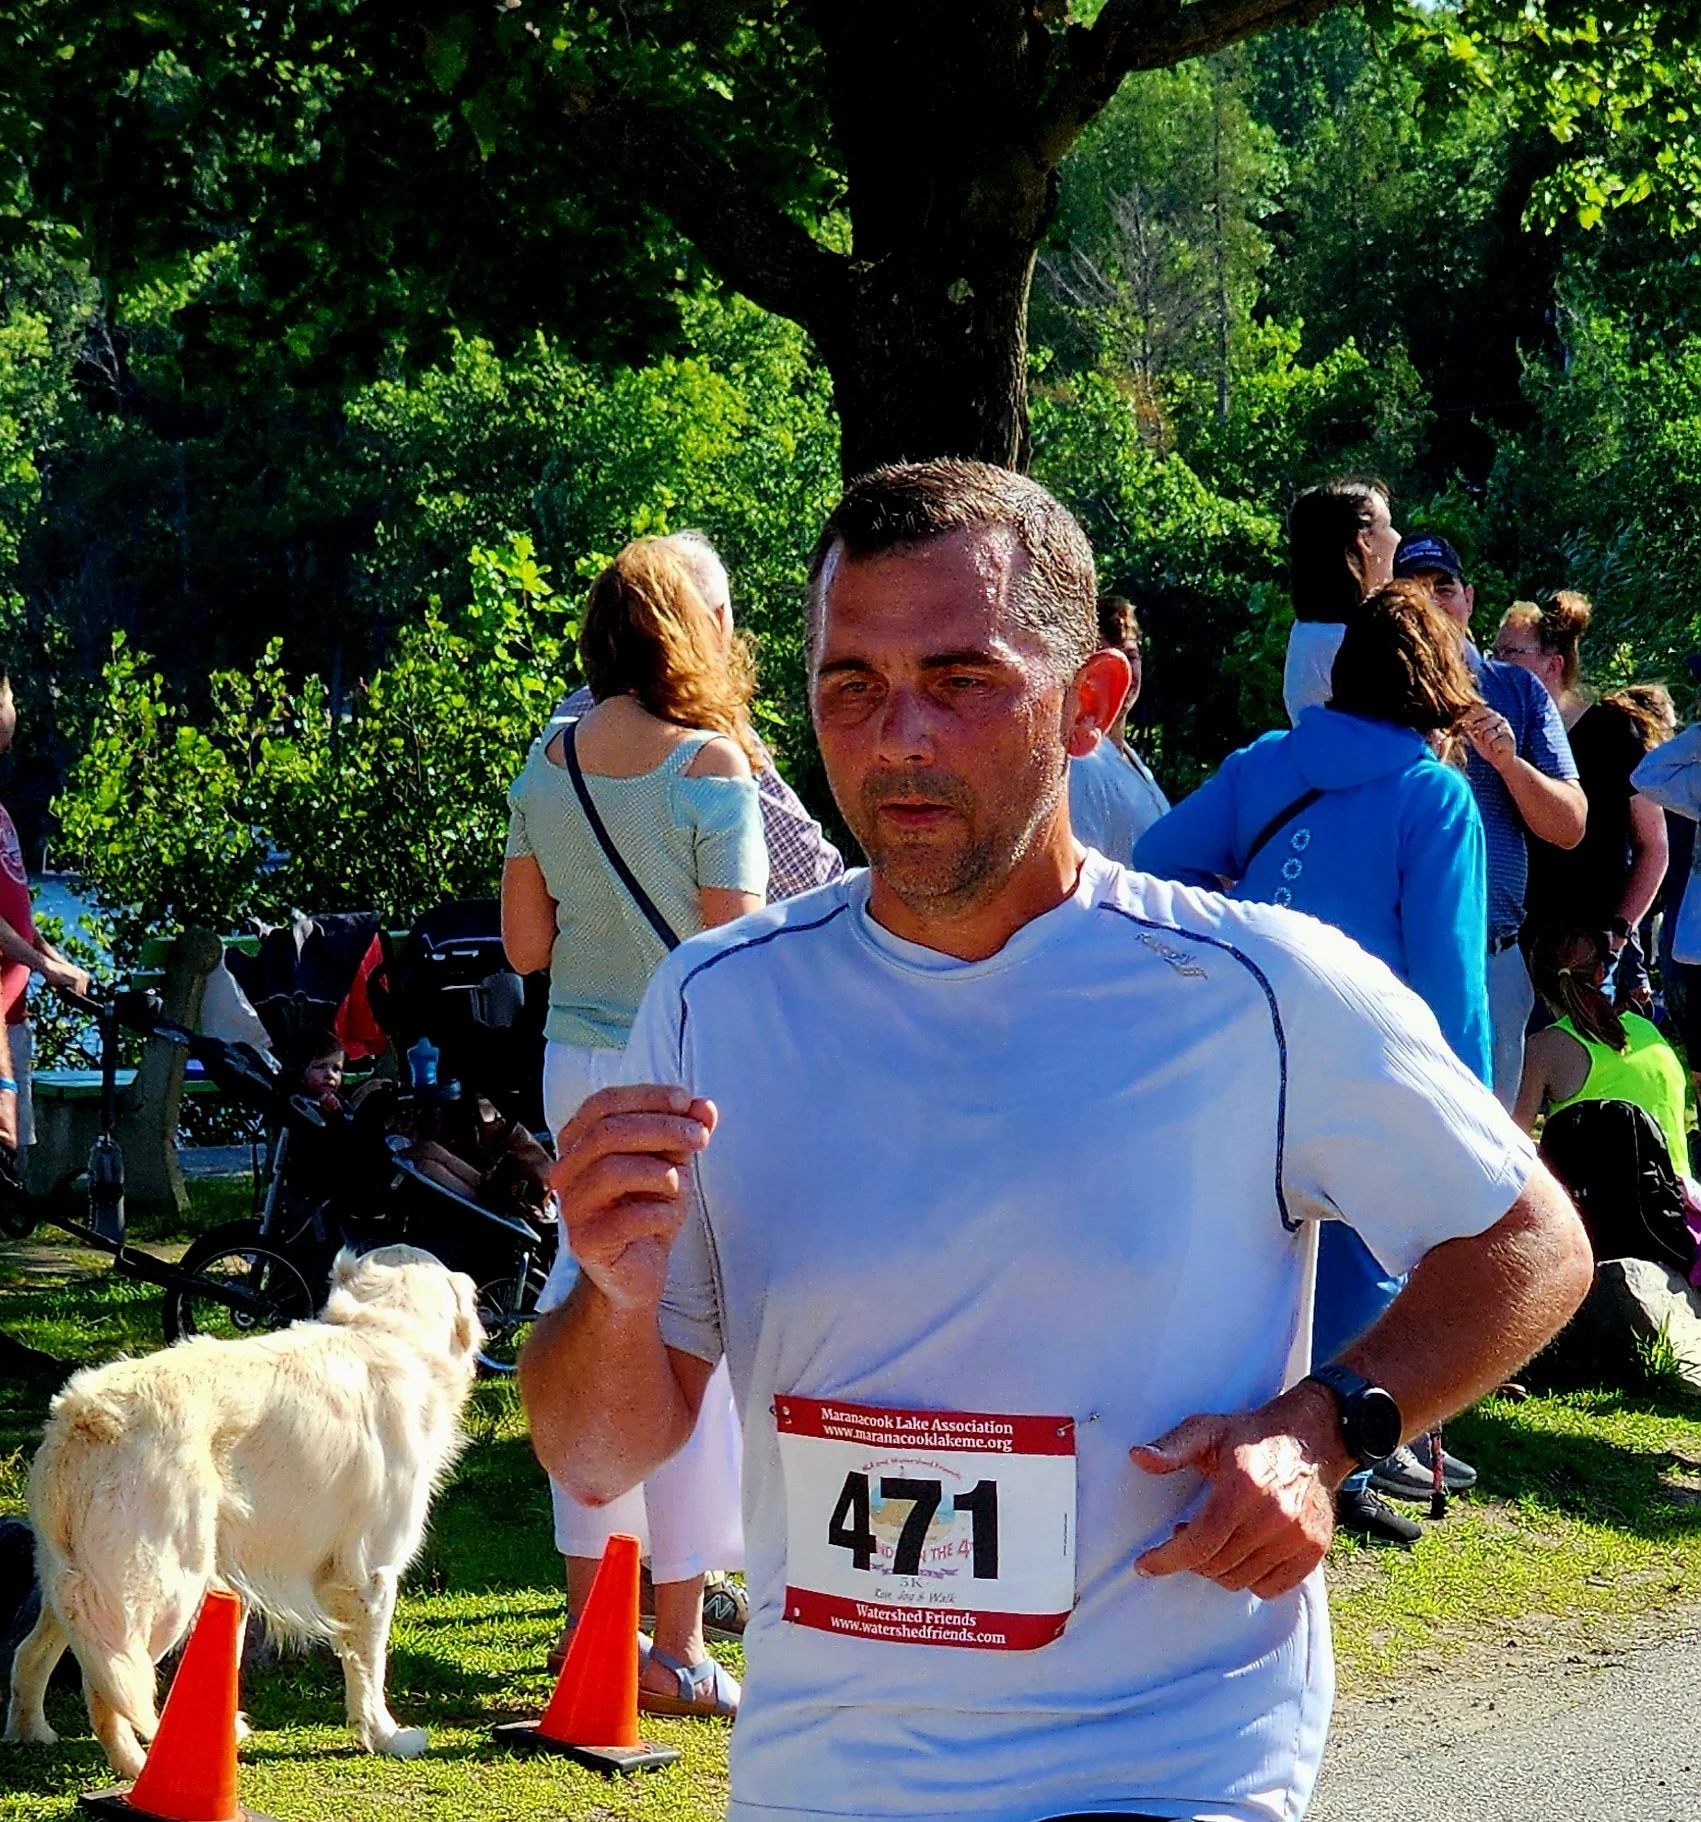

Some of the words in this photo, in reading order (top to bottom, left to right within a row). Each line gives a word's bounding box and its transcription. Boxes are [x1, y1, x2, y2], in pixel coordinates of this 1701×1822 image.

[821, 1407, 894, 1429] Maranacook
[895, 1416, 929, 1431] Lake
[931, 1418, 1013, 1435] Association
[823, 1425, 1013, 1453] www.maranacooklakeme.org
[828, 1471, 999, 1580] 471
[931, 1542, 953, 1561] THE
[900, 1576, 922, 1589] 5K
[929, 1592, 957, 1604] Walk
[856, 1603, 922, 1624] Watershed
[925, 1611, 977, 1627] Friends
[830, 1616, 1006, 1645] www.watershedfriends.com
